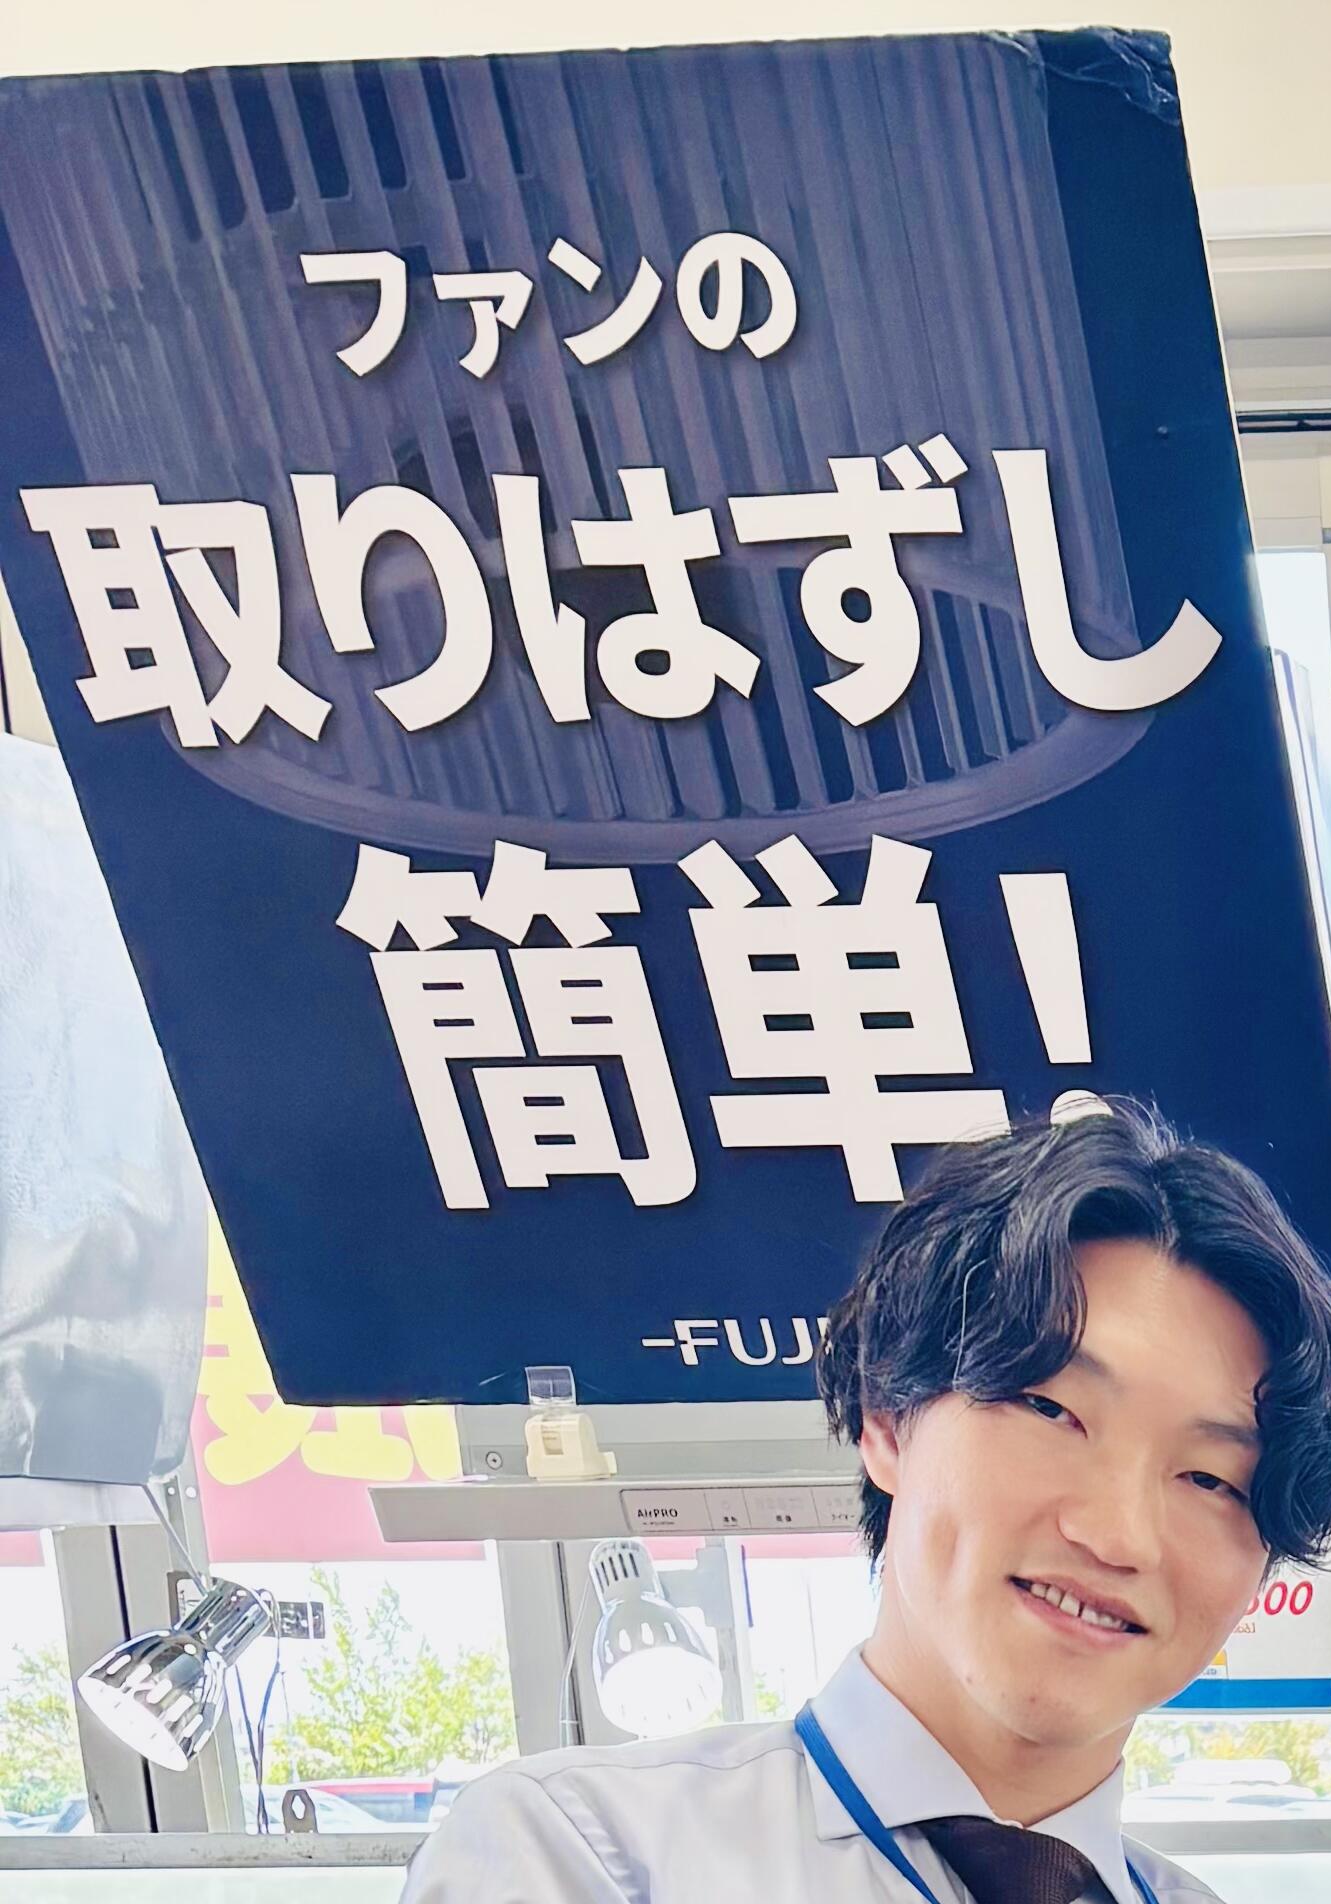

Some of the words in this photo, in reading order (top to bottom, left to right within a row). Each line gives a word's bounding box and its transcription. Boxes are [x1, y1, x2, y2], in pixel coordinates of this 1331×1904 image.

[300, 231, 798, 377] ファンの
[20, 433, 1224, 747] 取りはずし
[336, 834, 1113, 1209] 簡単!
